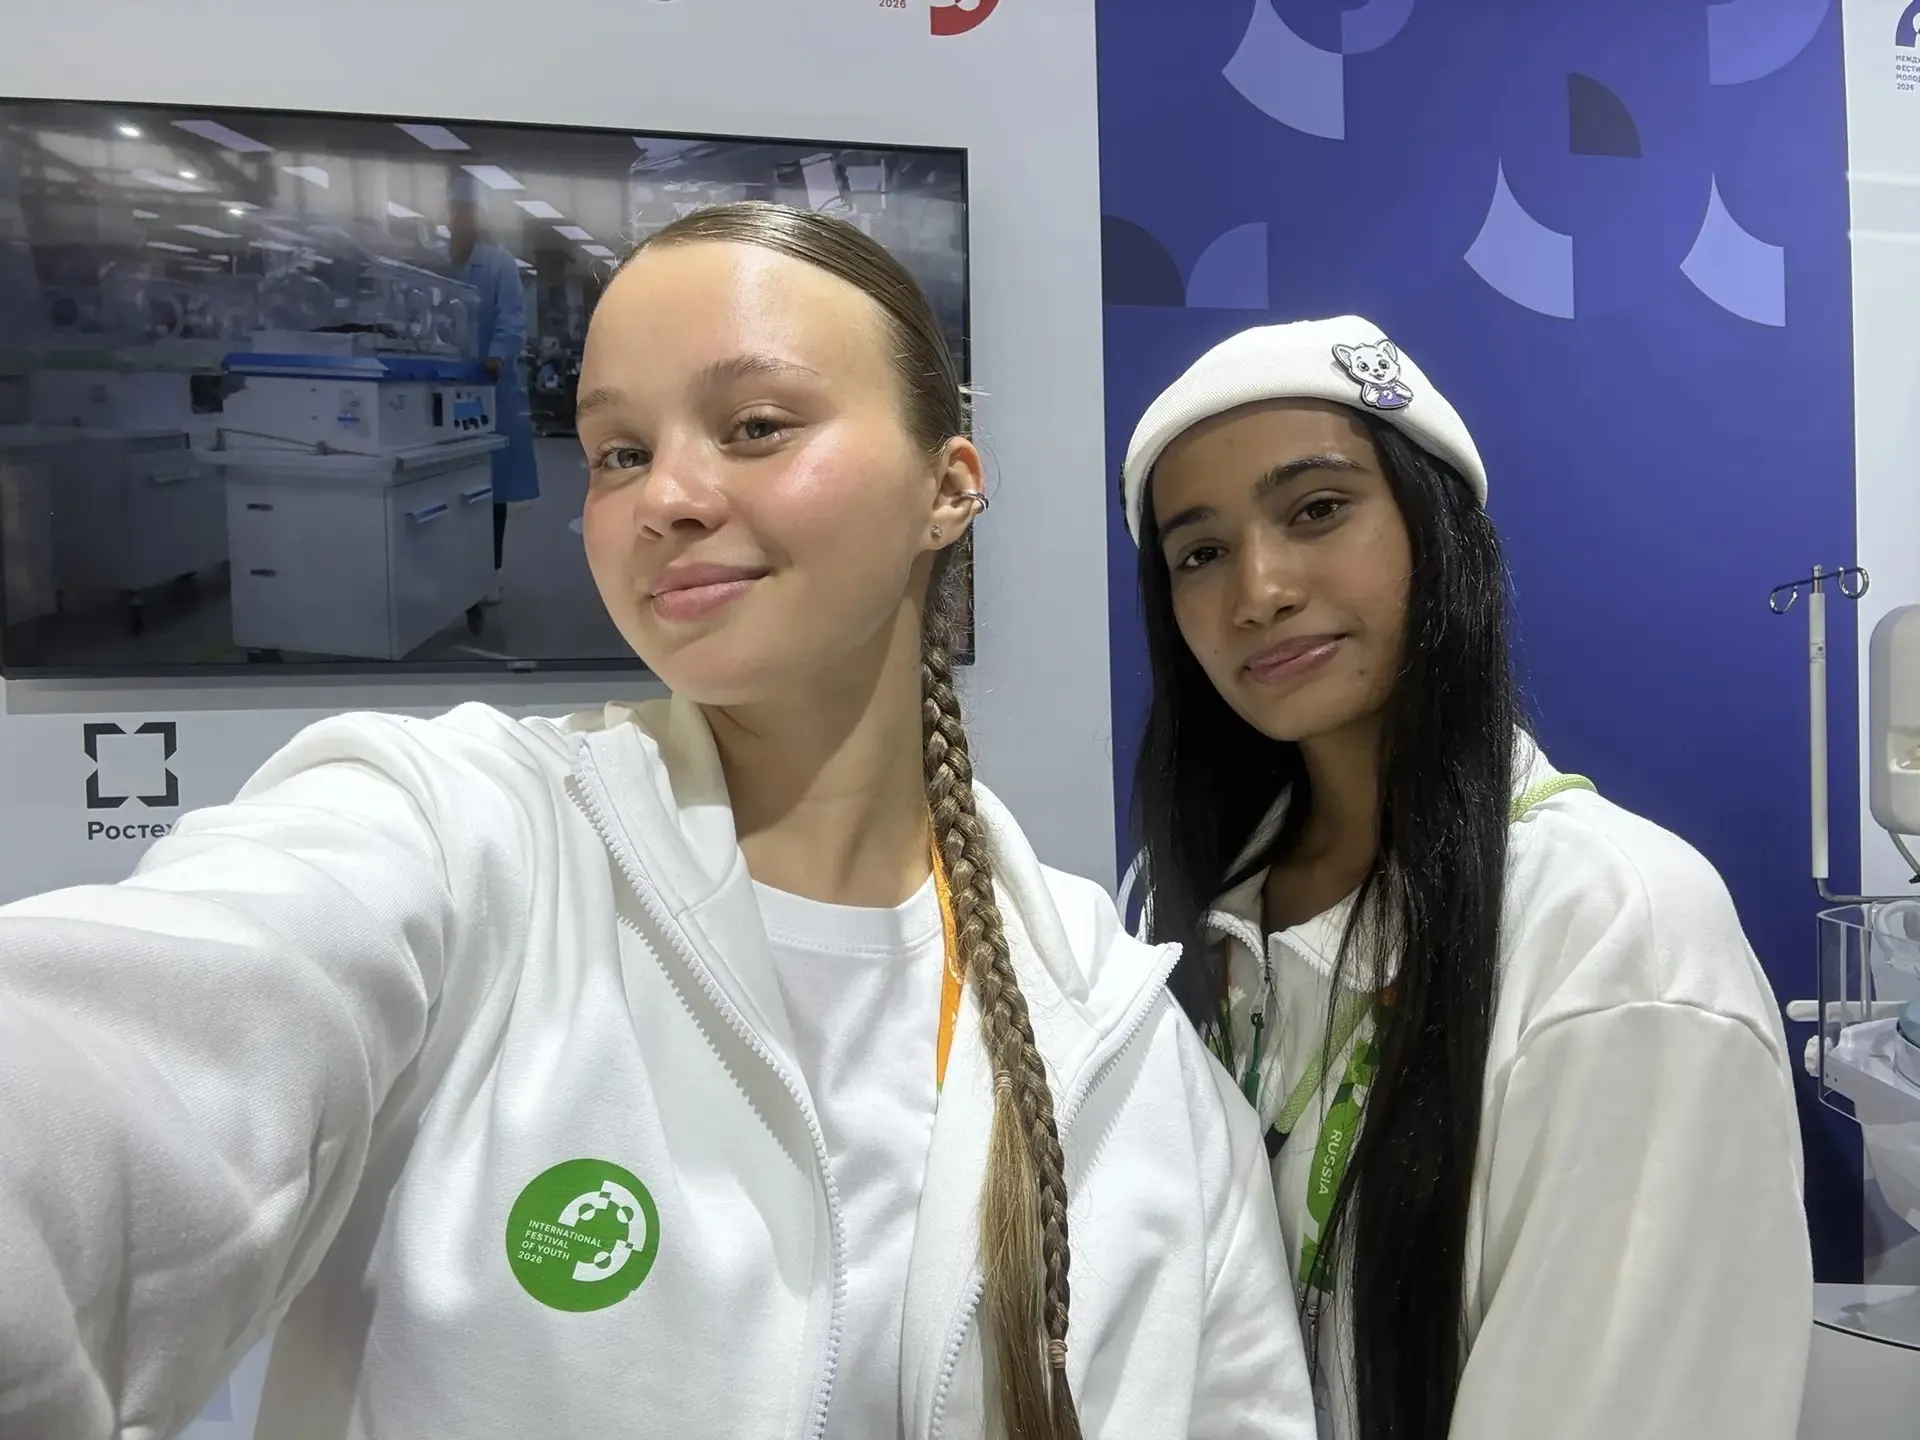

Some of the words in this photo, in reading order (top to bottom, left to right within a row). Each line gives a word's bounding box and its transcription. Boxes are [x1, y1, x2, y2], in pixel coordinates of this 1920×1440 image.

[879, 0, 907, 9] 2026
[1896, 83, 1915, 91] 2026
[87, 821, 173, 840] Росте
[1318, 1129, 1343, 1194] RUSSIA
[524, 1230, 569, 1249] FESTIVAL
[528, 1219, 602, 1248] INTERNATIONAL
[517, 1250, 543, 1264] 2026
[521, 1240, 536, 1251] OF
[537, 1245, 570, 1261] YOUTH
